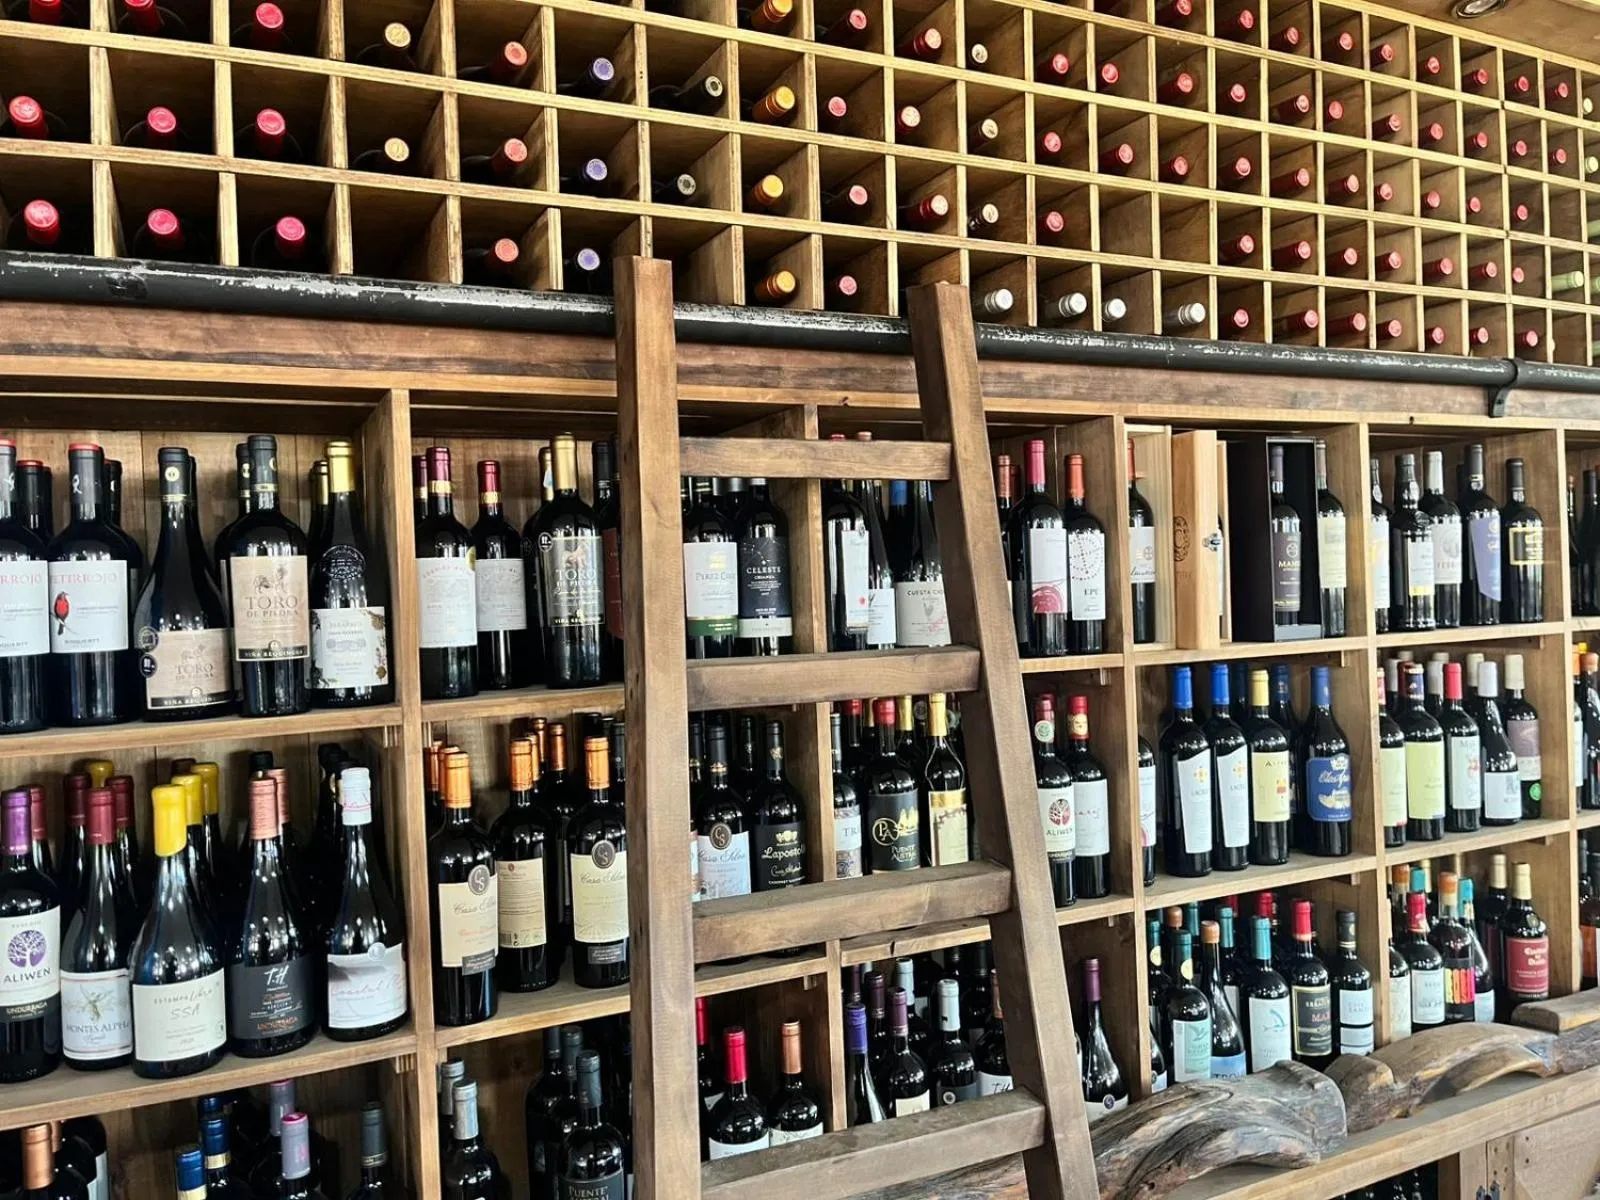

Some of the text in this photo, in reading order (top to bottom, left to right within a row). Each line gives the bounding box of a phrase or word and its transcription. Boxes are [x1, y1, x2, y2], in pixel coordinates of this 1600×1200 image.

[746, 565, 782, 575] CELESTE
[906, 589, 931, 597] CUESTA
[245, 595, 299, 610] TORO
[3, 967, 51, 983] ALIWEN
[569, 1186, 609, 1198] PUENTE
